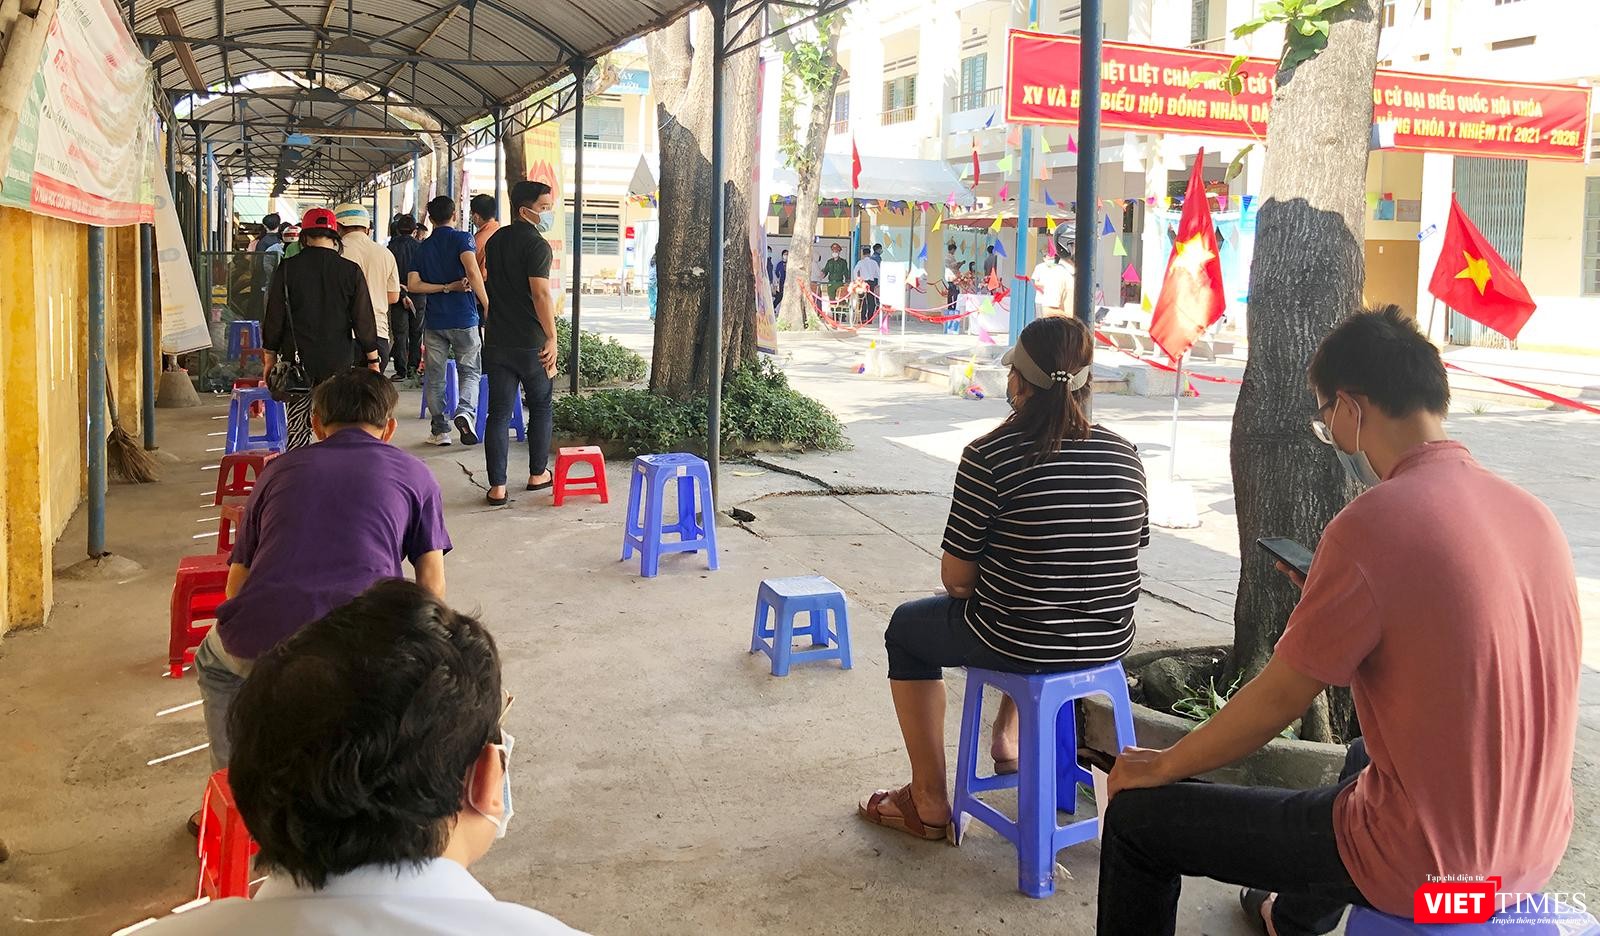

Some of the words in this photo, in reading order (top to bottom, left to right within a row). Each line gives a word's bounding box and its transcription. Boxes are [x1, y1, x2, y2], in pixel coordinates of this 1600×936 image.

[1022, 85, 1044, 105] XV
[1047, 84, 1066, 107] VÀ
[1101, 86, 1135, 112] BIỂU
[1138, 92, 1164, 118] HỘI
[1167, 93, 1206, 118] ĐỒNG
[1210, 100, 1248, 121] NHÂN
[1251, 102, 1270, 123] DÂ
[1413, 116, 1445, 137] KHÓA
[1447, 121, 1457, 138] X
[1459, 120, 1496, 143] NHIỆM
[1498, 122, 1513, 142] KỲ
[1514, 127, 1540, 143] 2021
[1101, 59, 1126, 85] IỆT
[1129, 62, 1160, 87] LIỆT
[1248, 72, 1267, 95] CỬ
[1384, 85, 1402, 107] CỬ
[1404, 90, 1425, 112] ĐẠI
[1427, 88, 1455, 112] BIỂU
[1457, 92, 1489, 114] QUỐC
[1491, 96, 1511, 118] HỘI
[1513, 98, 1543, 118] KHÓA
